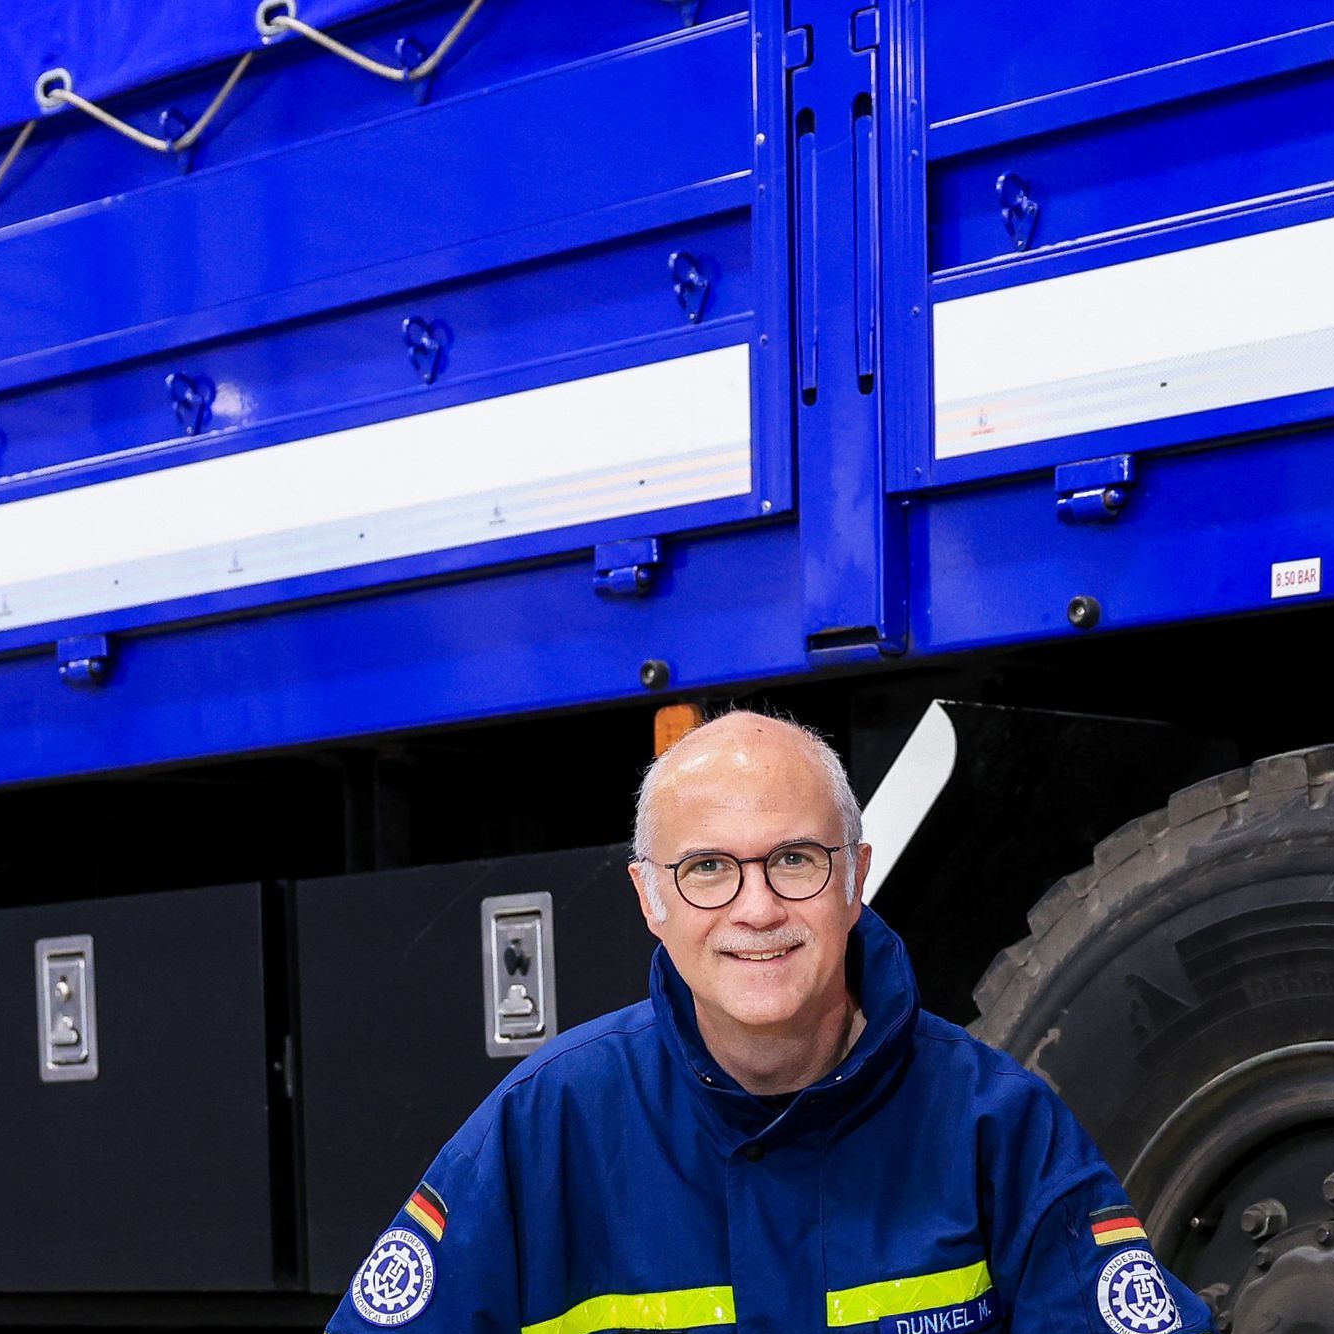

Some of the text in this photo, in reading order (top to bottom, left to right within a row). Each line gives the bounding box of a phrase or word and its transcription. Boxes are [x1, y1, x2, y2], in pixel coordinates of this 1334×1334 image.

[1276, 568, 1316, 587] 8.50 BAR
[399, 1231, 428, 1260] FEDERAL
[421, 1264, 434, 1302] AGENCY
[353, 1289, 383, 1323] TECHNICAL
[385, 1309, 411, 1325] RELIEF
[978, 1299, 992, 1321] M.
